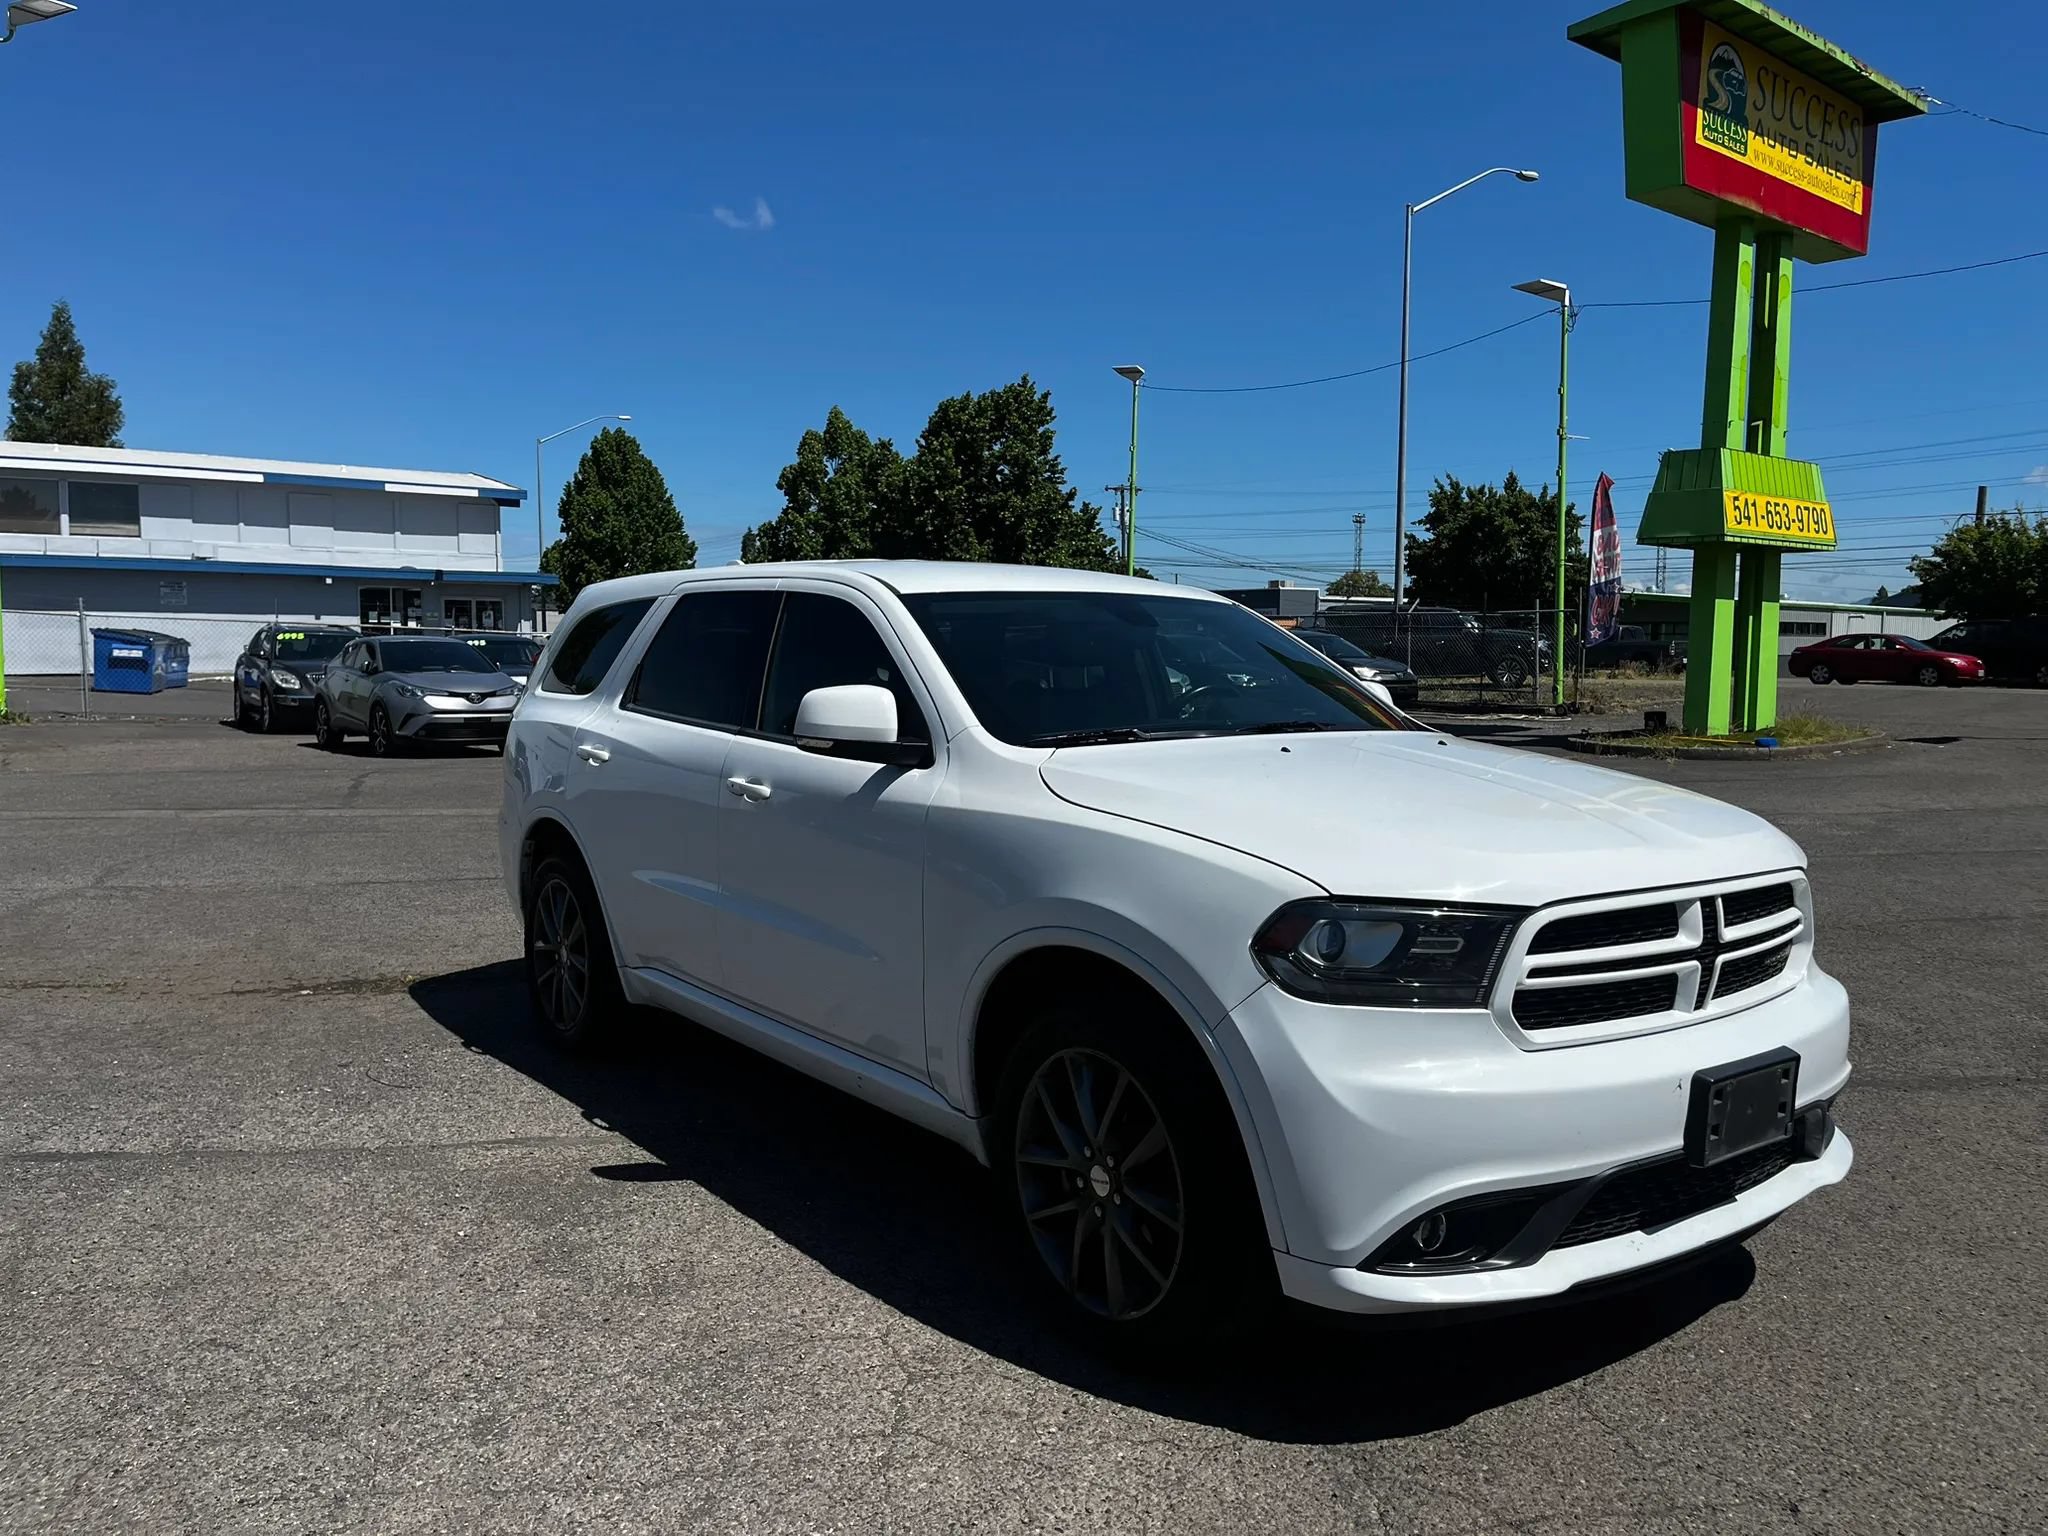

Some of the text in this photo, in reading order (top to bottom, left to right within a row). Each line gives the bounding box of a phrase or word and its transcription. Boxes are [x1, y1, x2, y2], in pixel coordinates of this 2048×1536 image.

[1703, 108, 1747, 142] SUCCESS
[1753, 65, 1860, 158] SUCCESS
[1703, 127, 1745, 153] AUTO SALES
[1753, 118, 1855, 185] AUTO SALES
[1732, 495, 1828, 535] 541-653-9790
